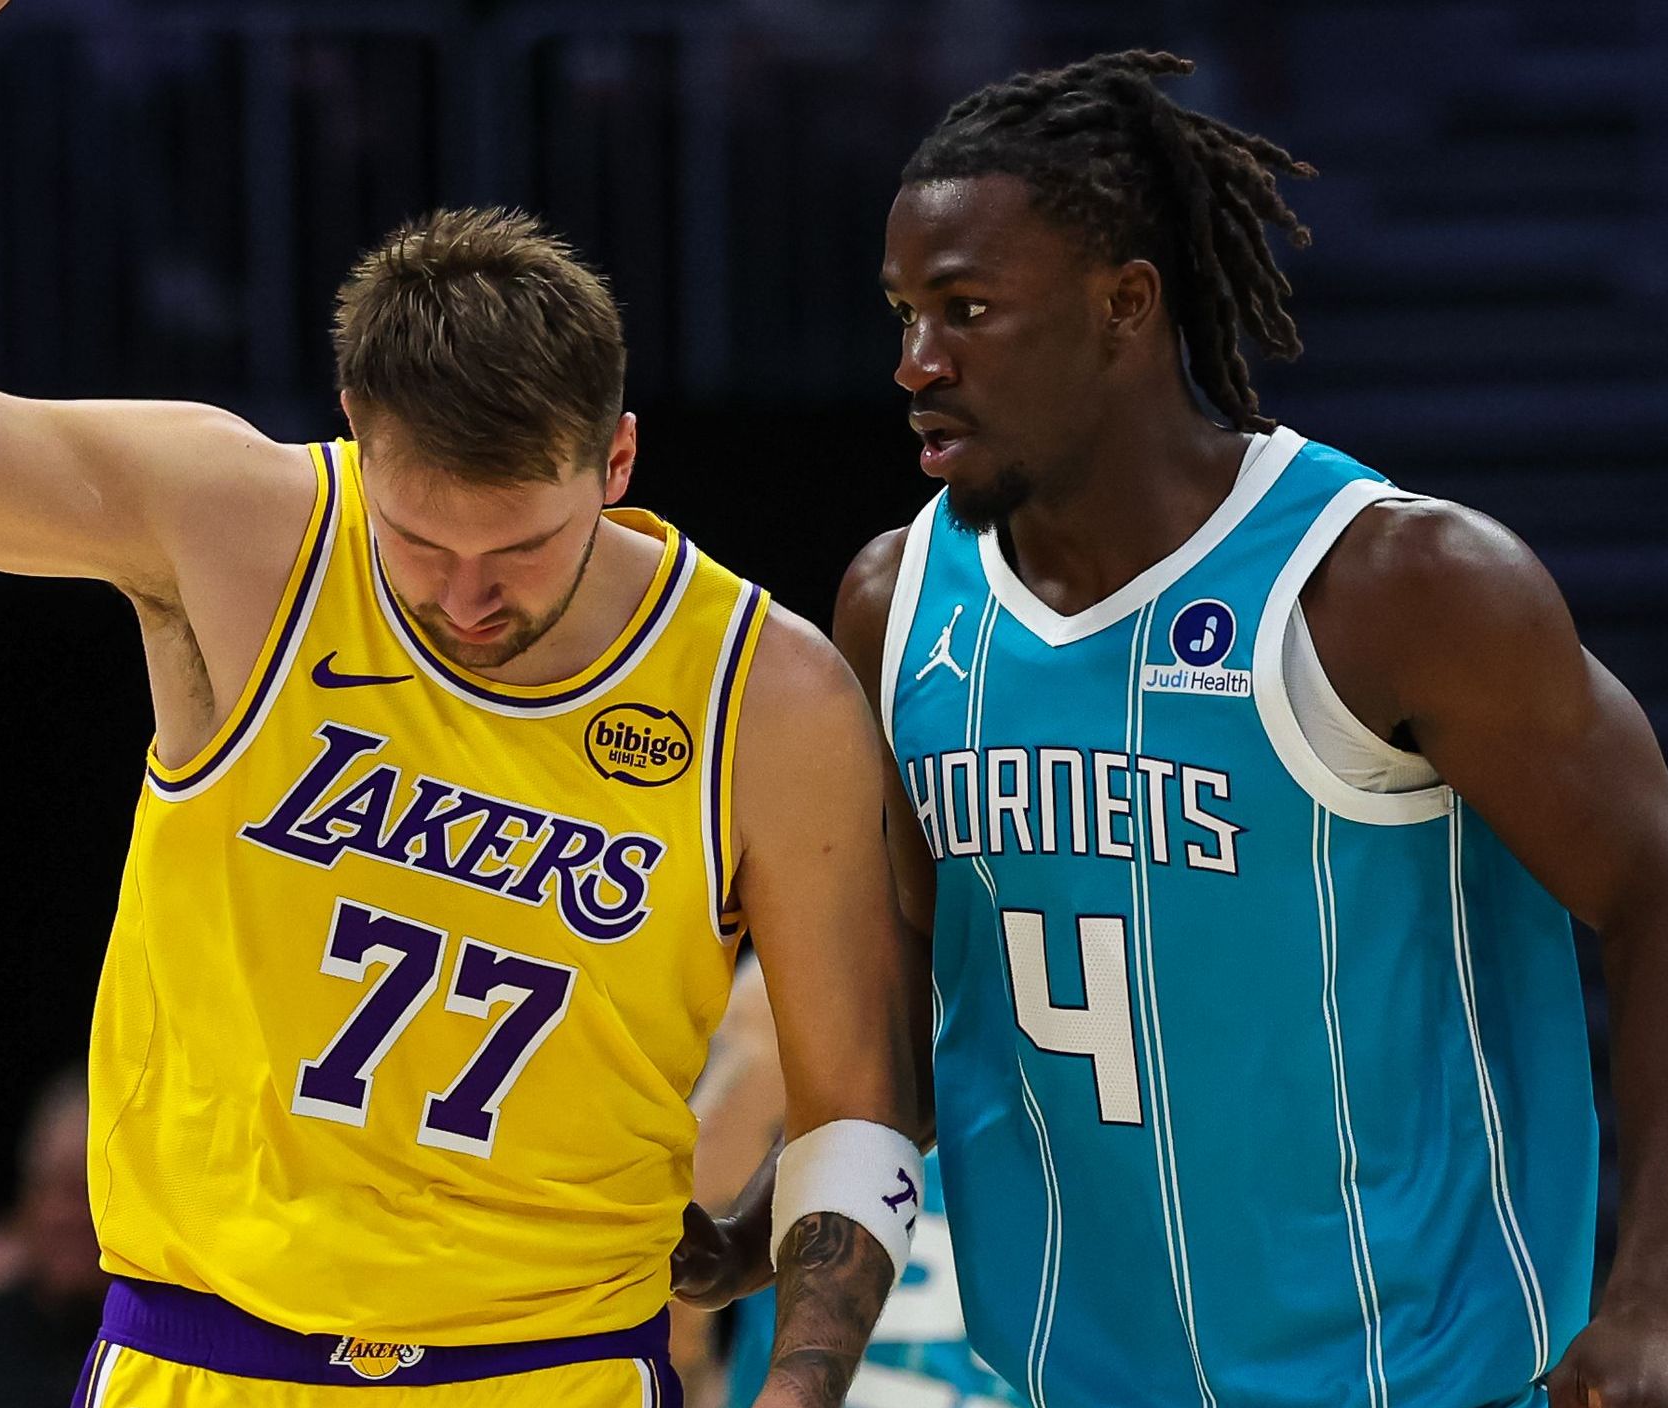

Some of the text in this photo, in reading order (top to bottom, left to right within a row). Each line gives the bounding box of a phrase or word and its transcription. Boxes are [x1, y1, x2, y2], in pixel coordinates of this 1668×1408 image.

[595, 721, 686, 766] bibigo
[1146, 669, 1248, 692] Judi Health
[609, 749, 646, 768] 비비고
[906, 747, 1249, 876] HORNETS
[237, 720, 668, 945] LAKERS
[290, 895, 579, 1159] 77
[999, 907, 1145, 1127] 4
